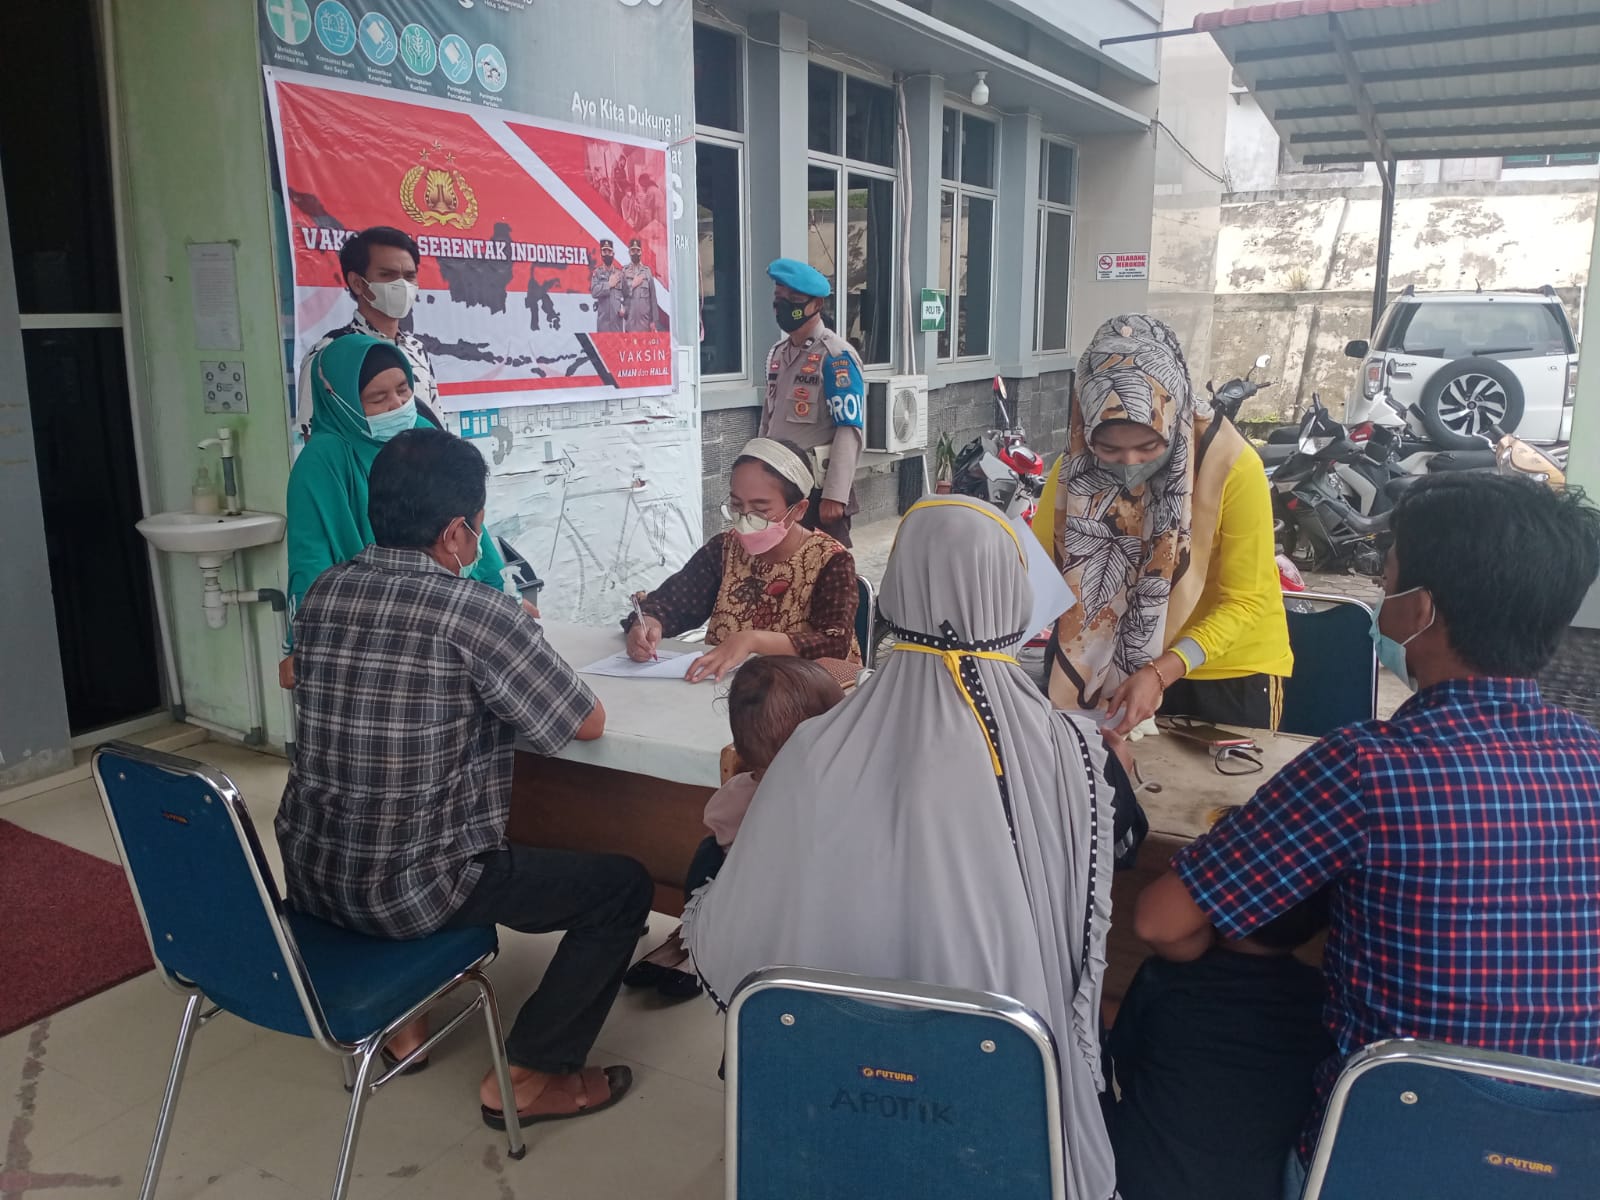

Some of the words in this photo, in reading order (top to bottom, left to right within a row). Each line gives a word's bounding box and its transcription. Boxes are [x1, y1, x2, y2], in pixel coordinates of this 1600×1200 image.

[571, 91, 597, 120] Ayo
[600, 98, 625, 123] Kita
[628, 104, 671, 137] Dukung
[417, 236, 507, 261] SERENTAK
[511, 242, 589, 265] INDONESIA
[619, 348, 666, 363] VAKSIN
[617, 369, 637, 378] AMAN
[649, 367, 670, 376] HALAL
[793, 375, 820, 386] POLRI
[875, 1069, 914, 1082] FUTURA
[829, 1087, 953, 1125] APOTIK
[1504, 1157, 1553, 1173] FUTURA
